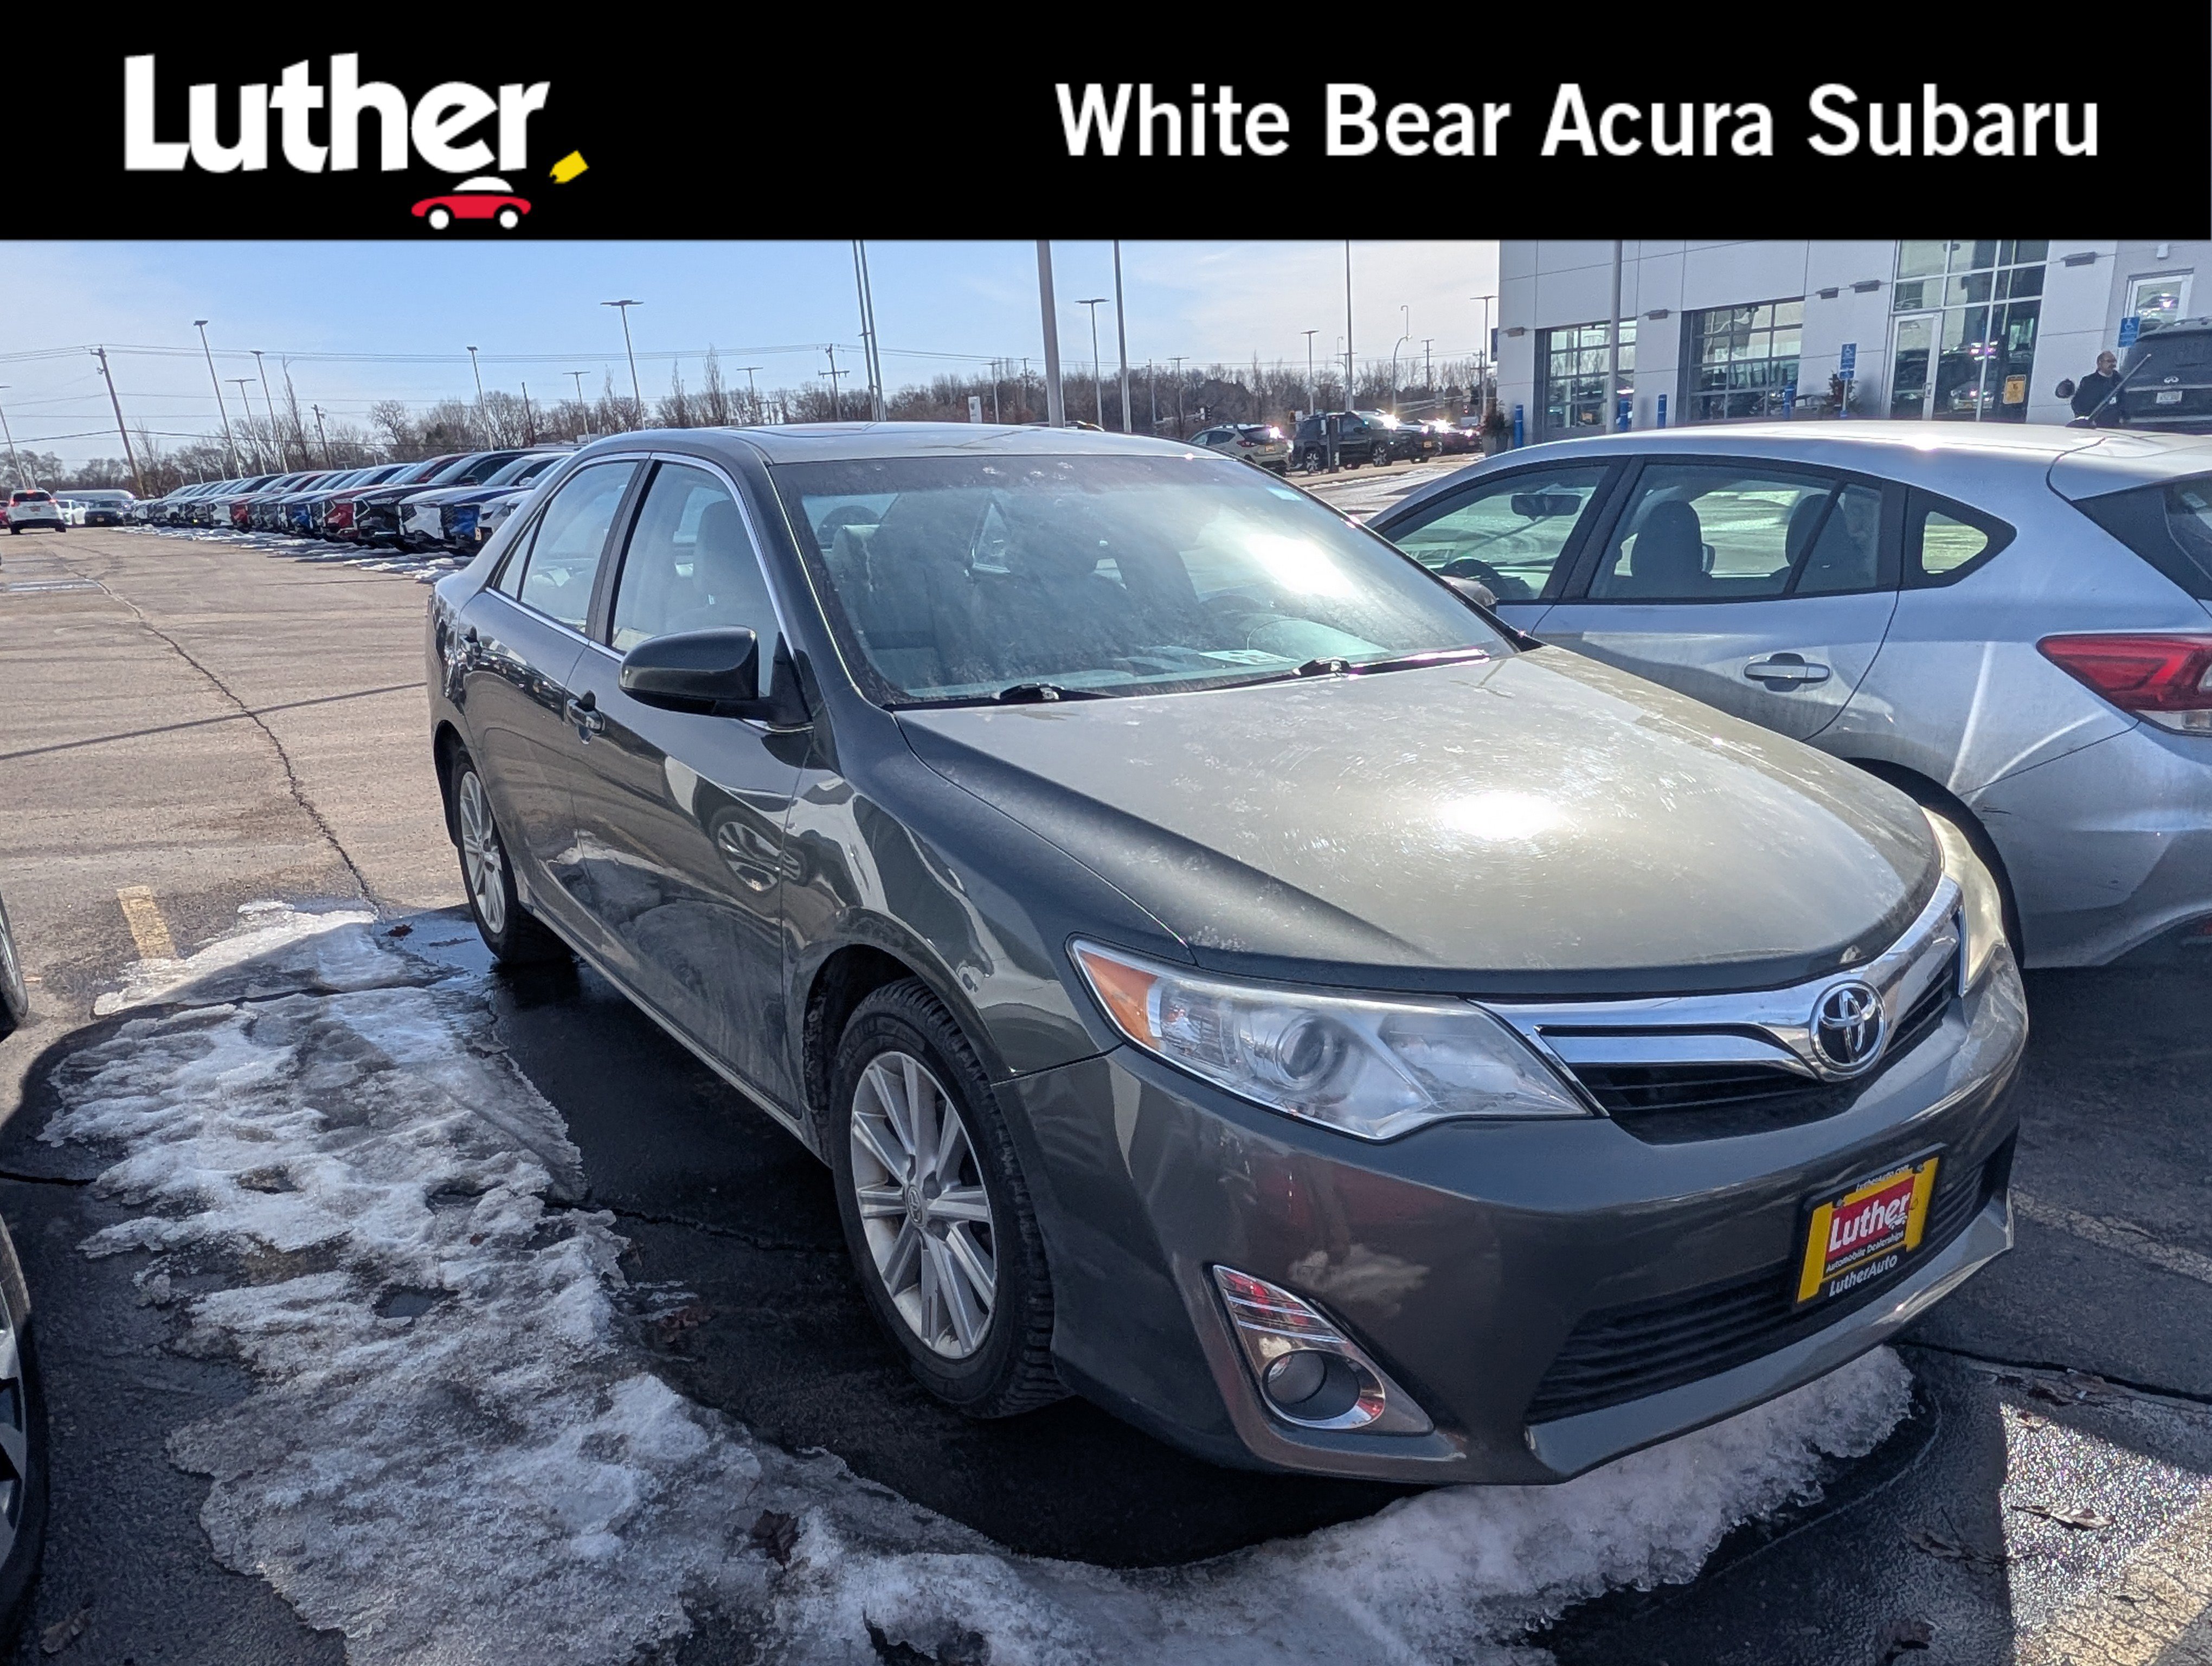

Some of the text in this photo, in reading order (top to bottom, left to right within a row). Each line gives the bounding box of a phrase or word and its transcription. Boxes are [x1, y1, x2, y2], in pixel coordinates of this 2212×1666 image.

[1829, 1193, 1911, 1252] Luther
[1826, 1248, 1866, 1273] Automobile
[1829, 1255, 1898, 1297] LutherAuto
